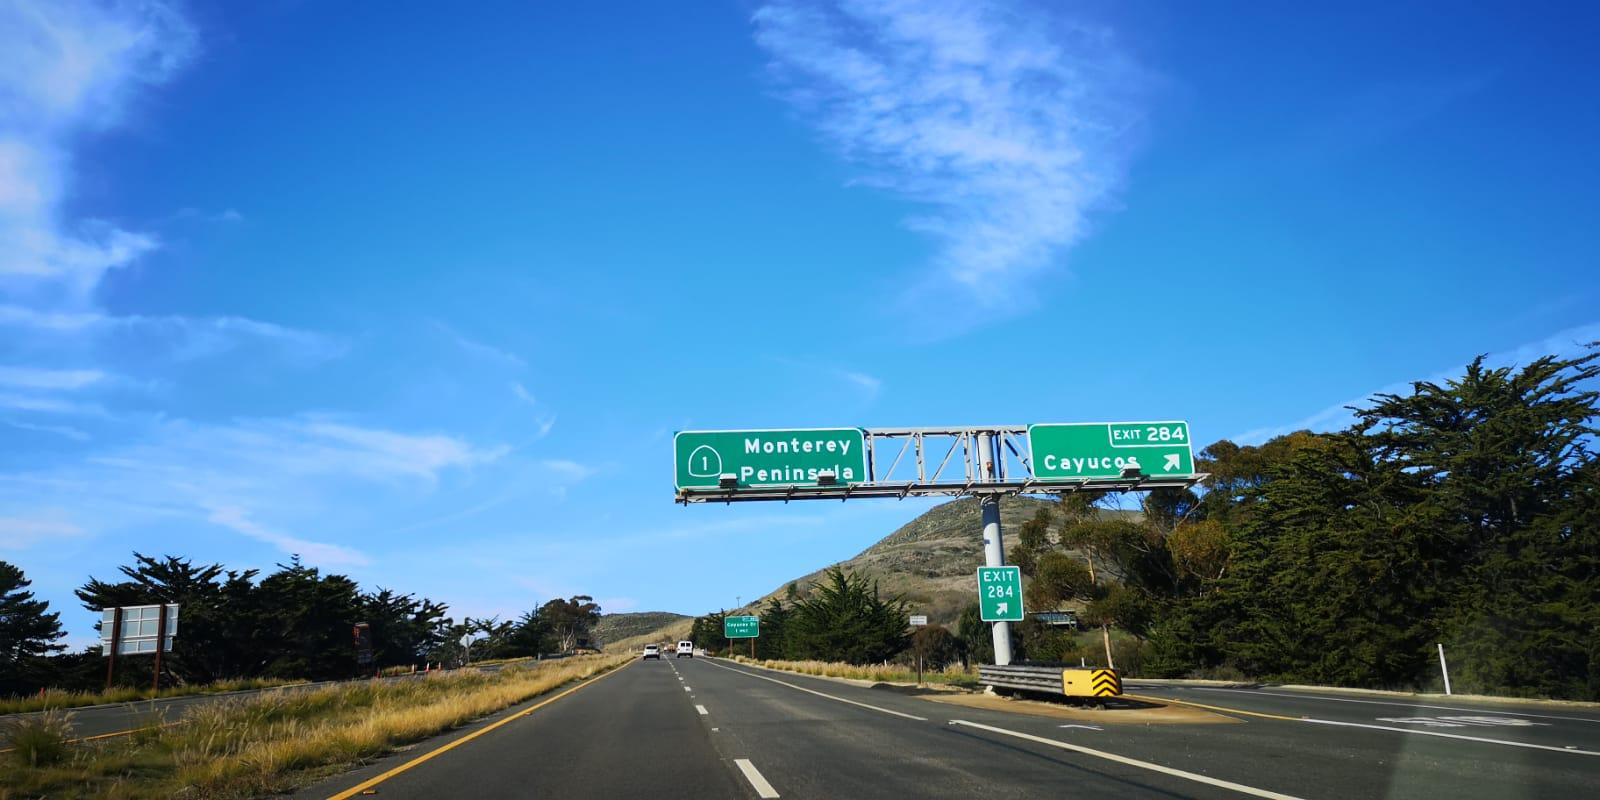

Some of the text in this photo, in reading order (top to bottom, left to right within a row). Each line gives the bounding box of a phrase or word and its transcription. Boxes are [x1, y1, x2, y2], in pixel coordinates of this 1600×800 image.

[1113, 426, 1185, 441] EXIT 284
[744, 438, 851, 456] Monterey
[702, 456, 707, 471] 1
[1044, 454, 1138, 473] Cayucos
[740, 464, 854, 482] Peninsla
[983, 571, 1014, 582] EXIT
[988, 585, 1013, 598] 284
